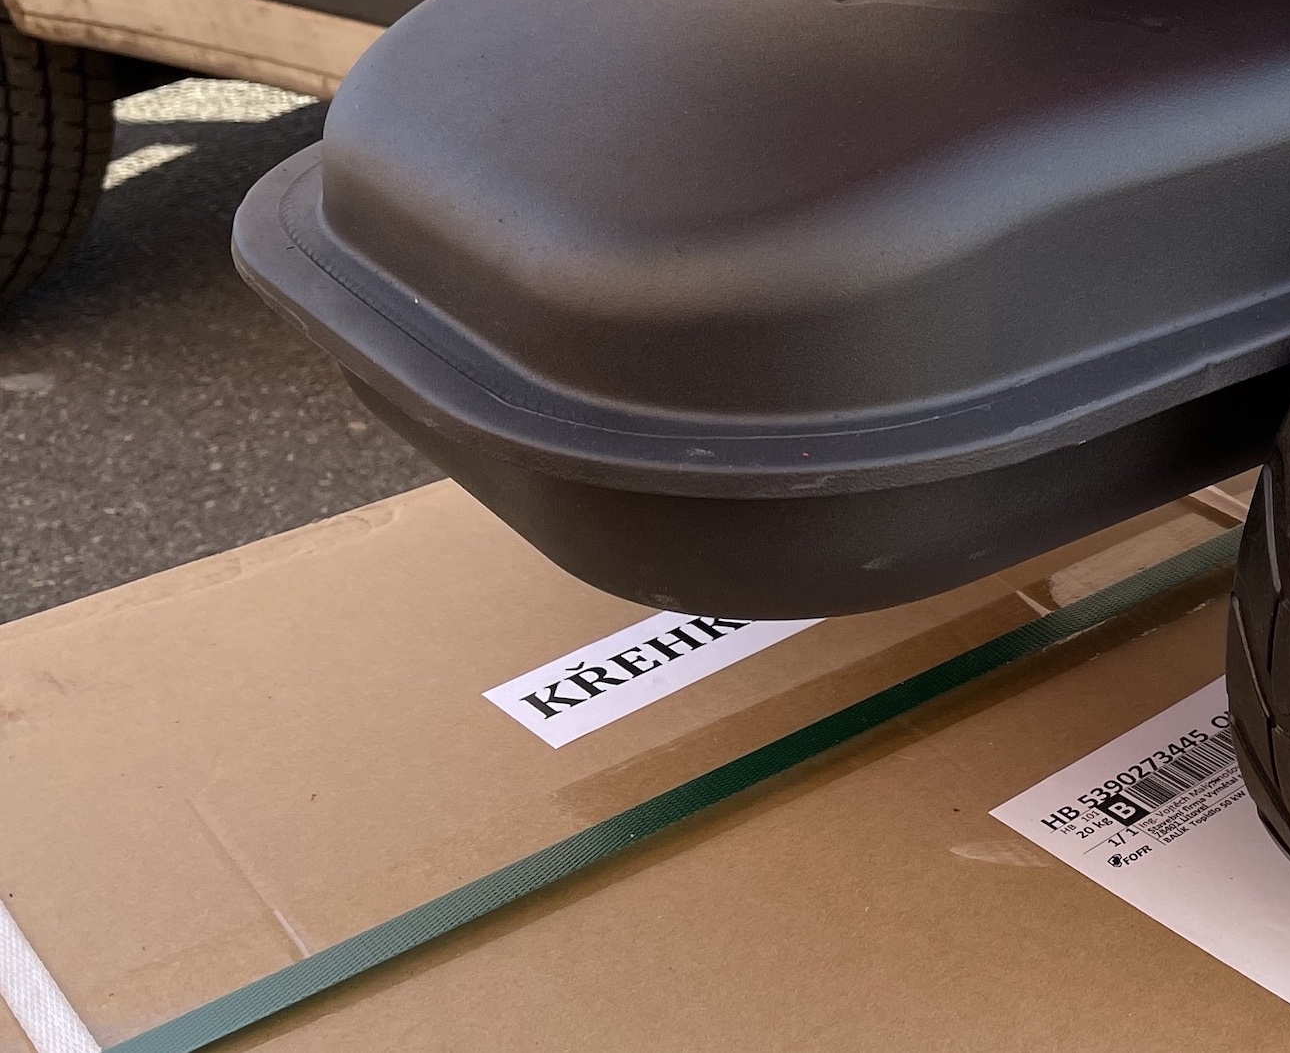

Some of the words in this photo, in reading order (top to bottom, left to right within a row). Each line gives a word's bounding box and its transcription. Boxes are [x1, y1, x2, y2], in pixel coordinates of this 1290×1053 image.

[1041, 805, 1080, 831] HB
[1077, 729, 1209, 809] 5390273445
[1107, 801, 1137, 820] B
[1182, 797, 1207, 813] firma
[1188, 807, 1222, 827] Topidlo
[1219, 798, 1233, 809] 50
[1230, 790, 1246, 802] kW
[1060, 824, 1077, 835] HB
[1075, 826, 1095, 839] 20
[1092, 817, 1114, 829] kg
[1122, 845, 1153, 865] FOFR
